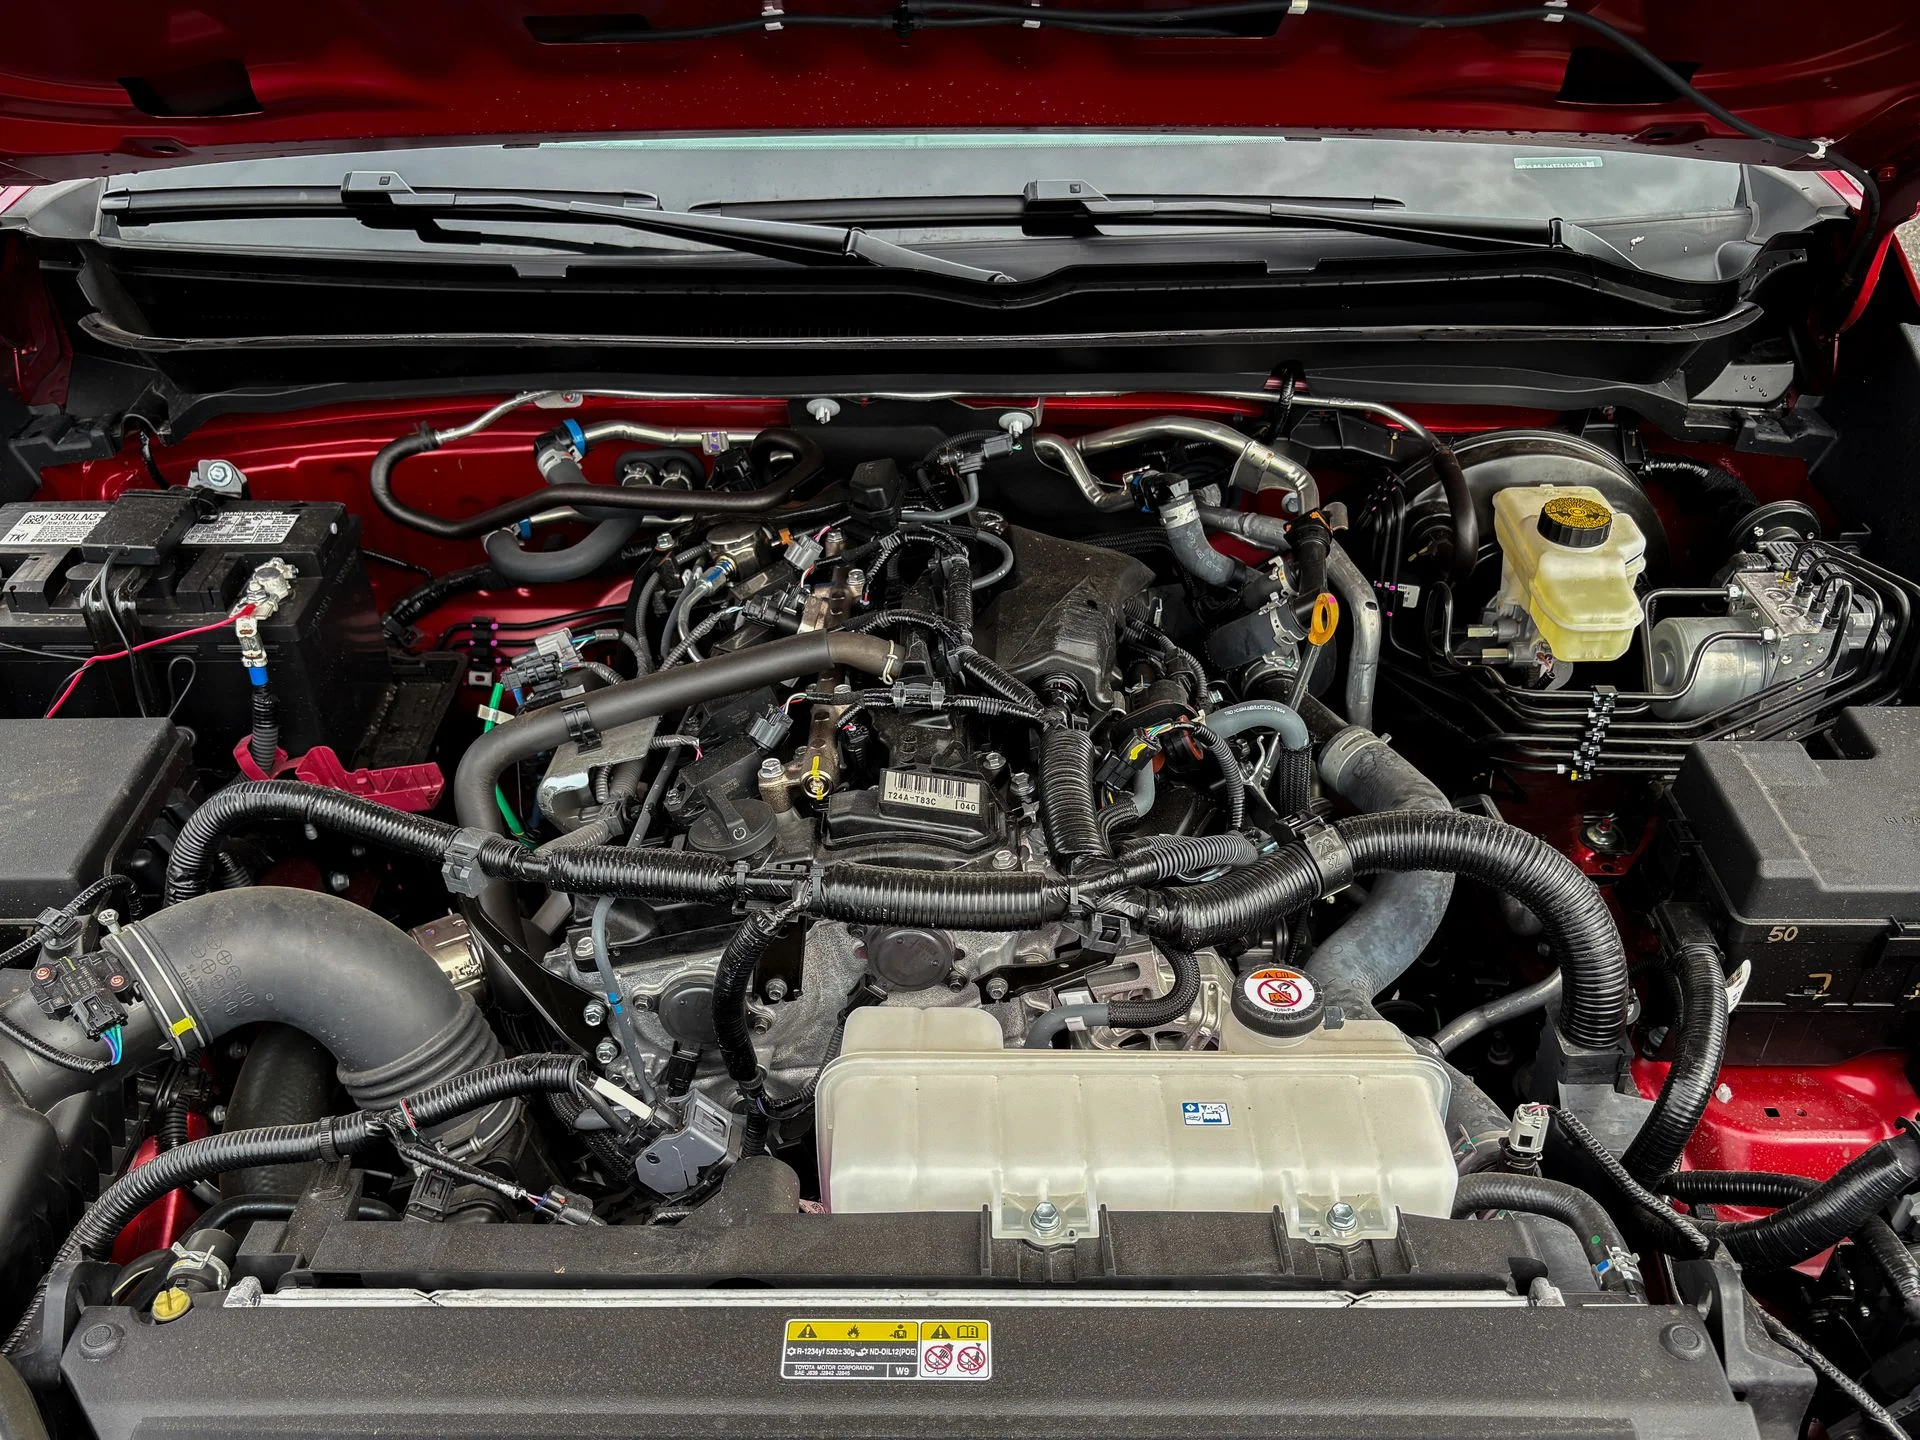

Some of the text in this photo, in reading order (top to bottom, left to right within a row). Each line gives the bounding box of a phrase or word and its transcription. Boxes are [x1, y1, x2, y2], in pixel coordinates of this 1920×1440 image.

[887, 791, 937, 806] T24A-T83C
[960, 802, 976, 812] 040
[1767, 926, 1799, 942] 50
[796, 1347, 918, 1357] R-1234yf 520±30g ND-OIL12(POE)
[895, 1366, 910, 1376] W9
